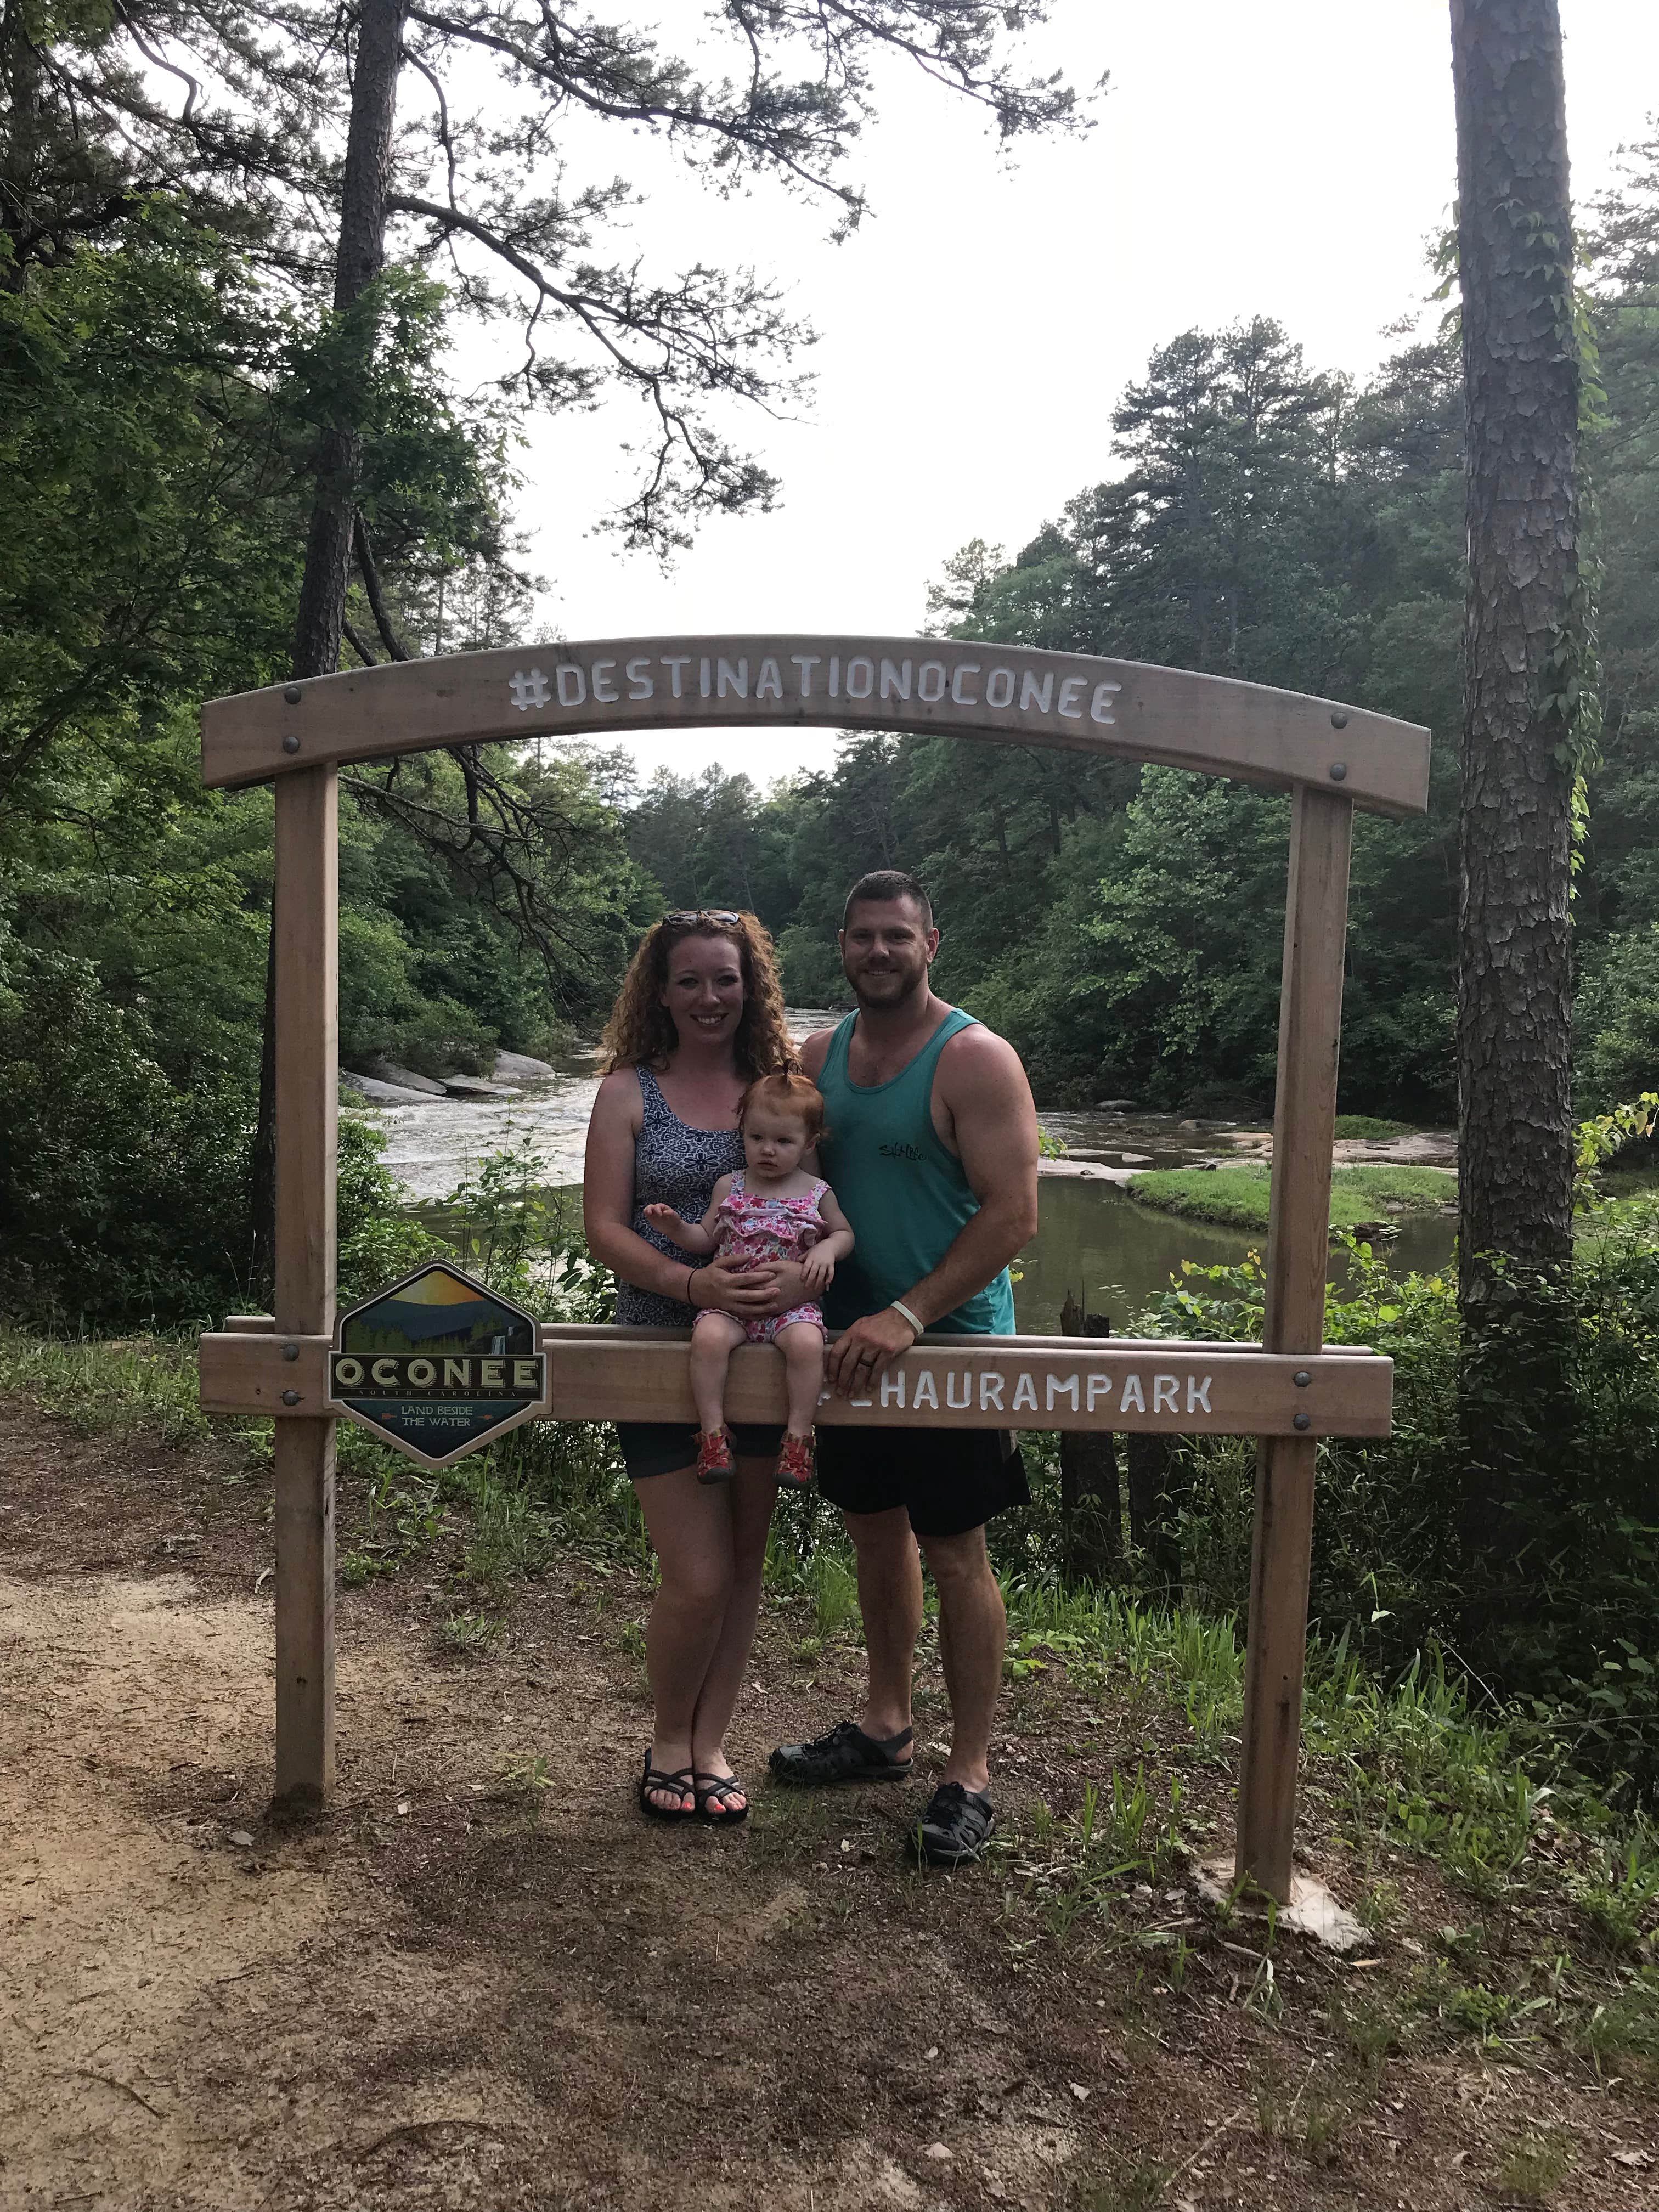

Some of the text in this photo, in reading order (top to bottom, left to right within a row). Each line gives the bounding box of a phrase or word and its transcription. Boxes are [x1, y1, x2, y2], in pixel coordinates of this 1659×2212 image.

[508, 654, 1122, 724] #DESTINATIONOCONEE
[335, 1358, 538, 1387] OCONEE
[817, 1369, 1213, 1413] HAURAMPARK
[402, 1406, 473, 1415] LAND BESIDE
[402, 1418, 470, 1426] THE WATER
